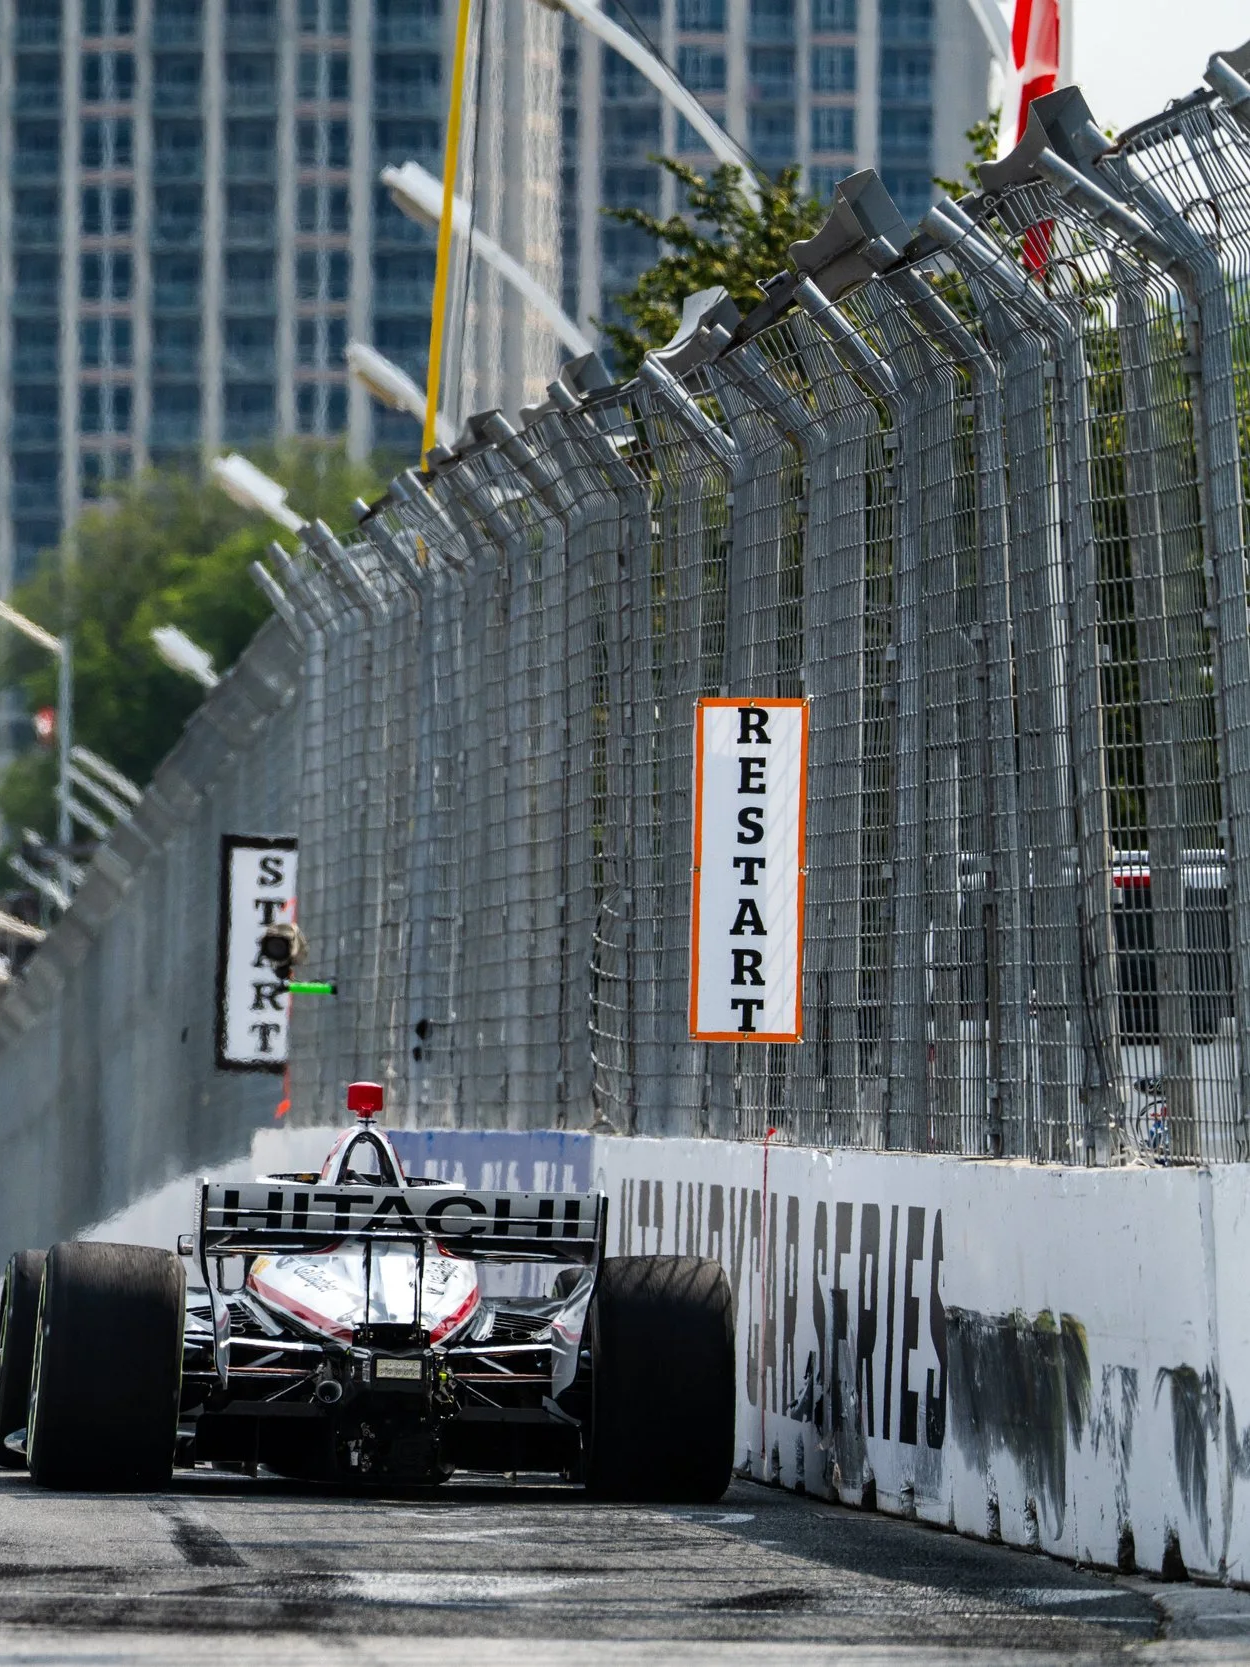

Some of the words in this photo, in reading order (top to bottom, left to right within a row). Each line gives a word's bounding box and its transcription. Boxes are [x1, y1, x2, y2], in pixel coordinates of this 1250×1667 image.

[729, 706, 772, 1033] RESTART
[222, 1189, 581, 1239] HITACHI
[812, 1201, 949, 1449] SERIES
